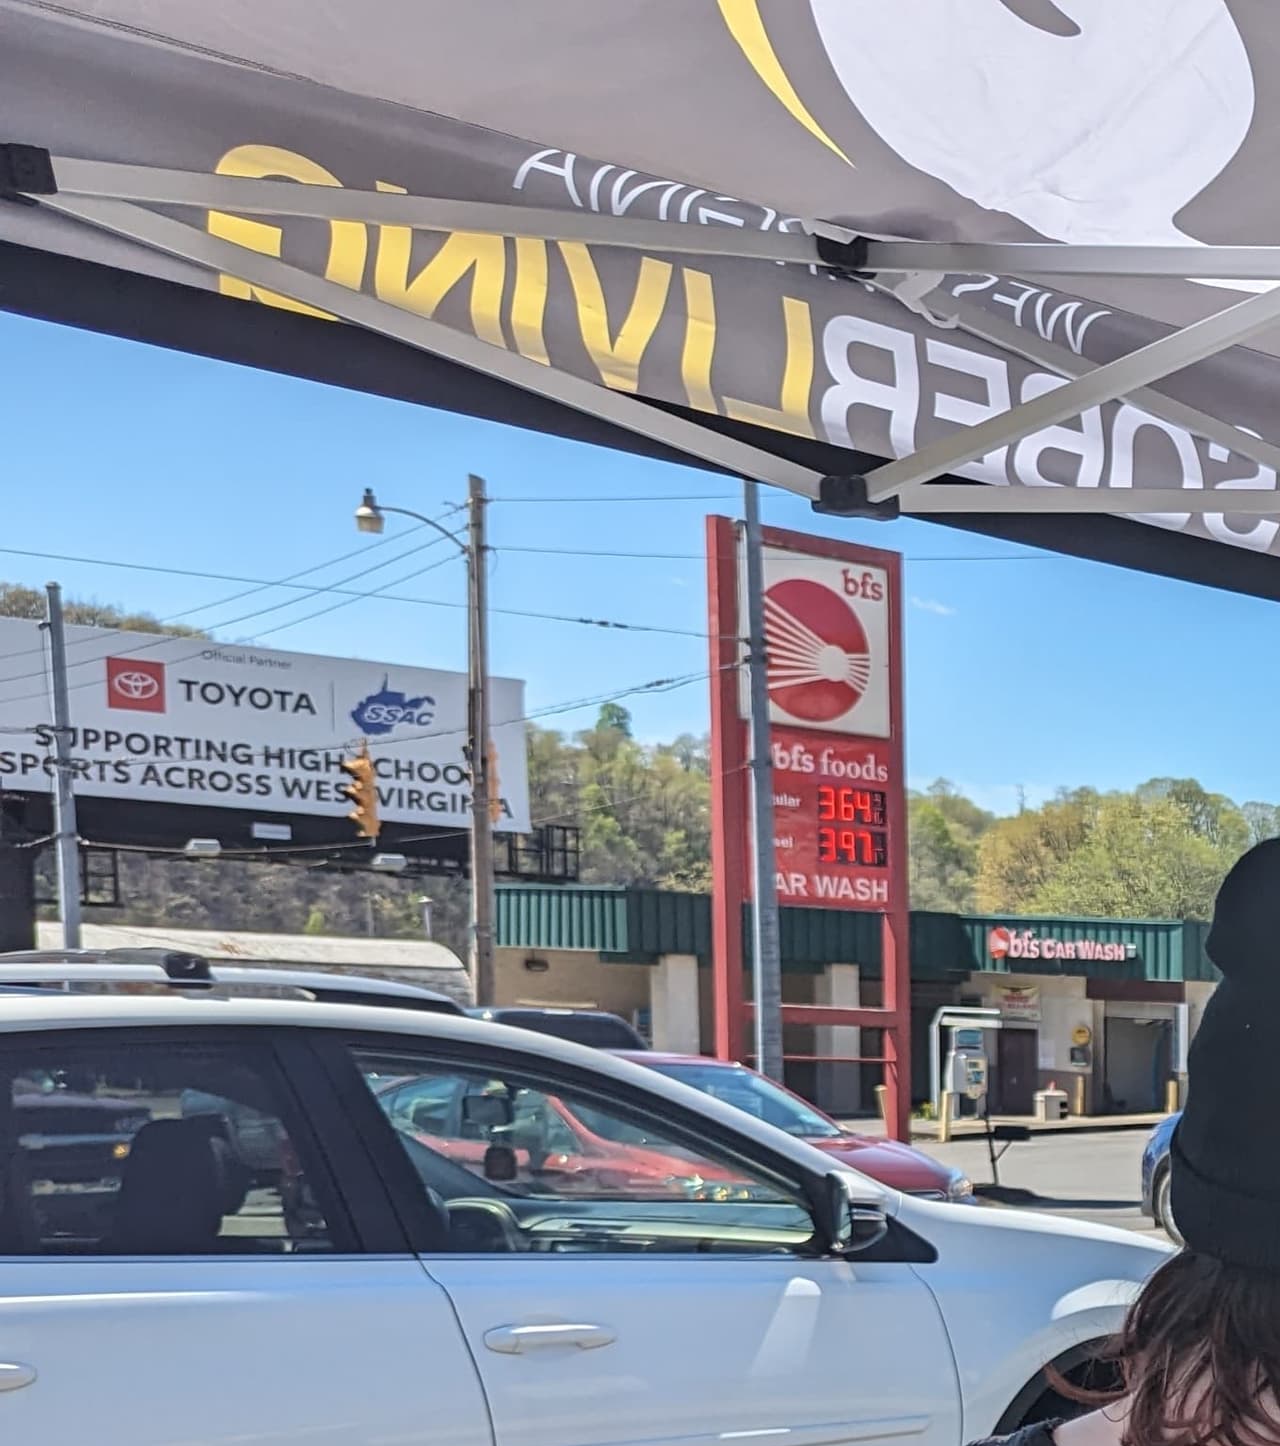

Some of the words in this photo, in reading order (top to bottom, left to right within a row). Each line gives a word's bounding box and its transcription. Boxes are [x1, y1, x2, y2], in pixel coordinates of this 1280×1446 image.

[843, 569, 883, 601] bfs
[201, 648, 248, 665] Official
[250, 654, 293, 671] Partner
[179, 679, 317, 715] TOYOTA
[364, 702, 434, 727] SSAC
[264, 746, 345, 775] HIGH
[374, 756, 466, 785] CHOO
[821, 749, 889, 783] foods
[140, 764, 273, 797] ACROSS
[281, 774, 347, 803] WES
[816, 873, 889, 903] WASH
[1009, 929, 1040, 959] bfs
[1041, 937, 1076, 960] CAR
[1077, 939, 1126, 962] WASH
